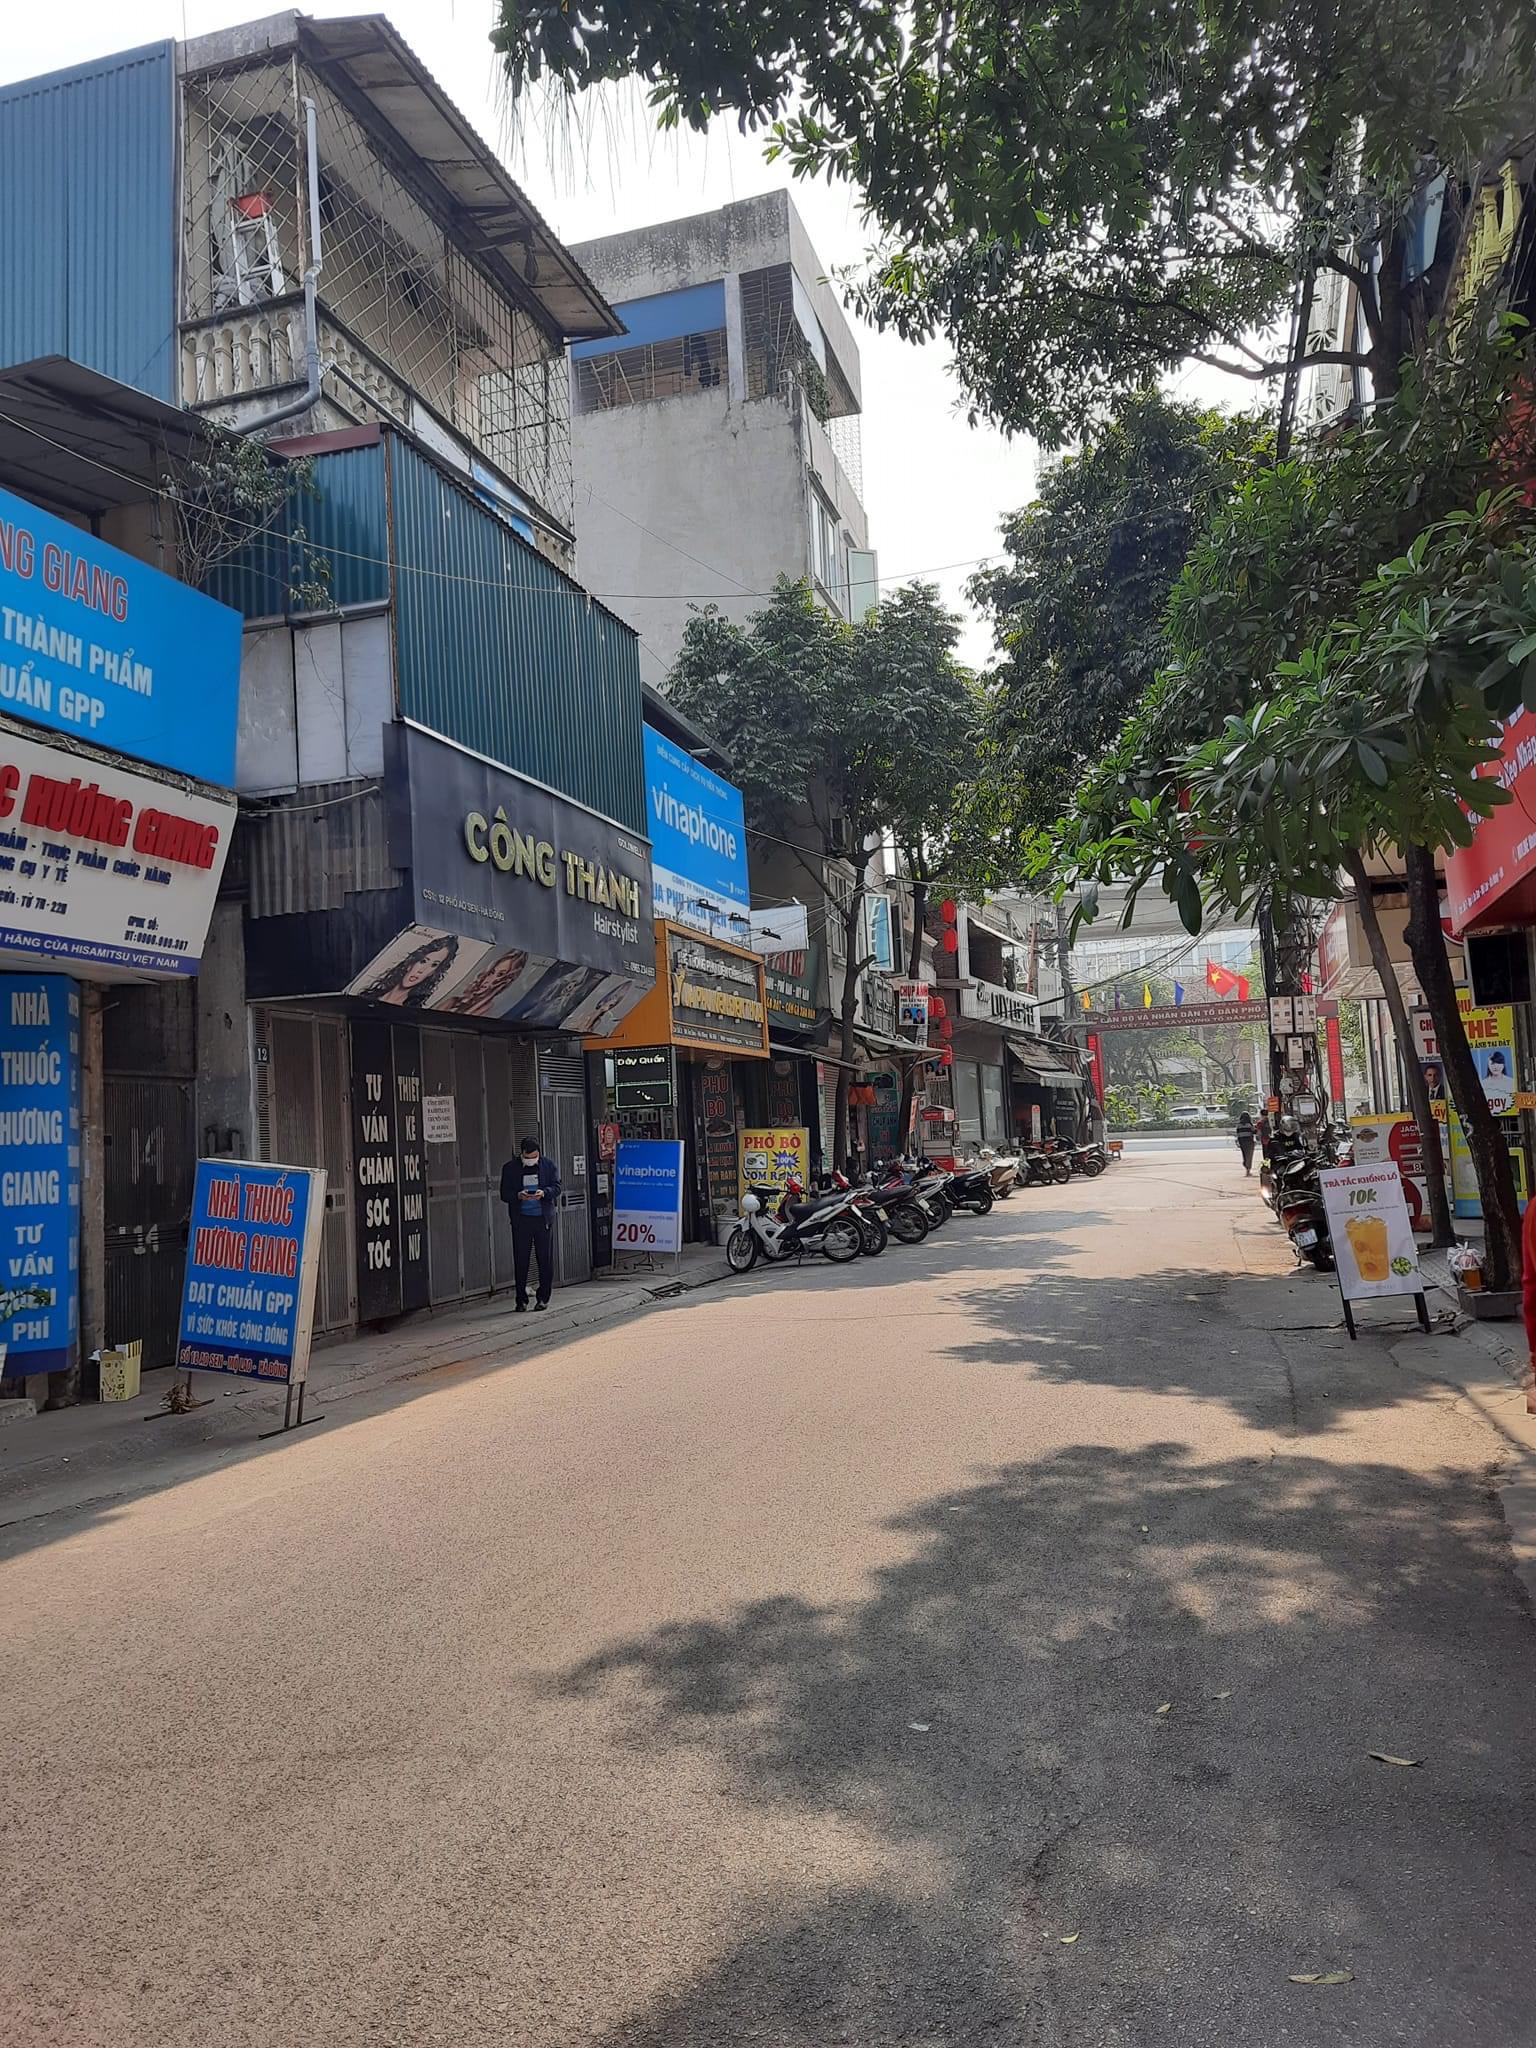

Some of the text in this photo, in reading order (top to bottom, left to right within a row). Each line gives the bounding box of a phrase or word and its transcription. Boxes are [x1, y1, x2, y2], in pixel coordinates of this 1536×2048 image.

[43, 542, 129, 623] GIANG
[1, 605, 153, 698] THÀNH PHẨM
[59, 686, 105, 728] GPP
[20, 774, 133, 848] HƯƠNG
[133, 808, 219, 870] GIANG
[652, 782, 737, 861] vinaphone
[43, 864, 51, 879] Y
[144, 866, 172, 886] NĂNG
[465, 804, 641, 919] CÔNG THANH
[594, 911, 639, 946] Hairstylist
[43, 938, 69, 952] CỦA
[71, 943, 130, 961] HISAMITSU
[132, 953, 155, 967] VIỆT
[156, 956, 180, 969] NAM
[11, 986, 50, 1025] NHÀ
[1137, 1012, 1149, 1022] VÀ
[1152, 1010, 1178, 1020] NHÂN
[1180, 1008, 1200, 1018] DÂN
[1218, 1005, 1238, 1015] DÂN
[1241, 1004, 1262, 1014] PHỐ
[1, 1039, 61, 1085] THUỐC
[257, 1047, 268, 1061] 12
[366, 1073, 382, 1102] TƯ
[398, 1068, 420, 1103] THIẾT
[707, 1096, 727, 1118] BÒ
[0, 1108, 63, 1145] HƯƠNG
[361, 1106, 388, 1143] VẤN
[405, 1108, 416, 1142] KẾ
[743, 1131, 776, 1149] PHỞ
[779, 1132, 802, 1149] BÒ
[359, 1151, 395, 1186] CHĂM
[404, 1149, 420, 1181] TÓC
[618, 1164, 677, 1179] vinaphone
[775, 1156, 796, 1164] 100%
[2, 1170, 60, 1207] GIANG
[1323, 1179, 1341, 1189] TRÀ
[1341, 1176, 1357, 1187] TẮC
[207, 1173, 295, 1227] NHÀ THUỐC
[366, 1191, 391, 1228] SÓC
[404, 1193, 423, 1222] NAM
[14, 1223, 44, 1245] TƯ
[132, 1223, 160, 1255] 14
[617, 1223, 656, 1244] 20%
[9, 1251, 53, 1277] VẤN
[193, 1225, 298, 1278] HƯƠNG GIANG
[367, 1234, 391, 1270] TÓC
[188, 1280, 293, 1315] ĐẠT CHUẨN GPP
[13, 1317, 49, 1341] PHÍ
[197, 1313, 214, 1335] SỨC
[239, 1320, 263, 1344] CỘNG
